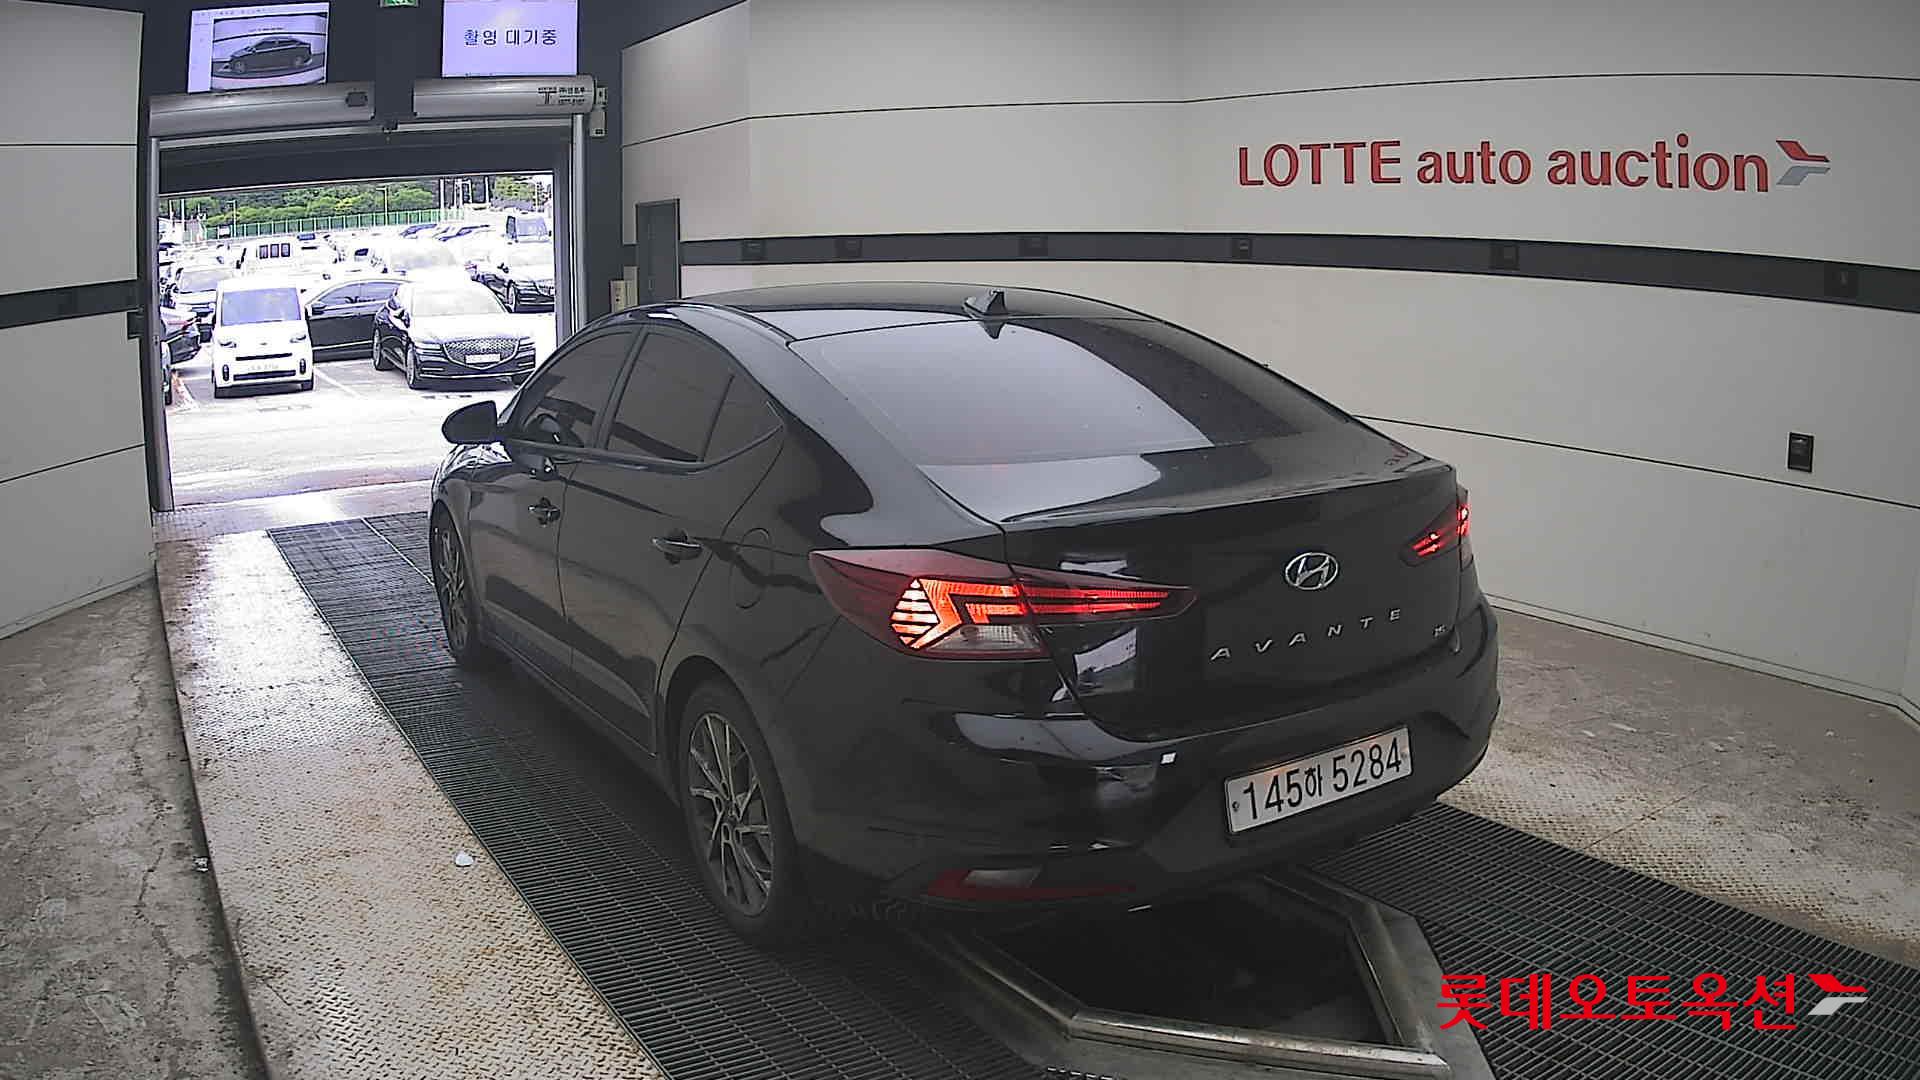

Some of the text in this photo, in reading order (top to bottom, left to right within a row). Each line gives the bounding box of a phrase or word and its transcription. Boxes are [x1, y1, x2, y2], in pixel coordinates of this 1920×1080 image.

[505, 29, 557, 46] 대기중
[1239, 134, 1770, 193] LOTTE auto auction
[1209, 608, 1401, 662] AVANTE
[1243, 737, 1402, 819] 145하 5284
